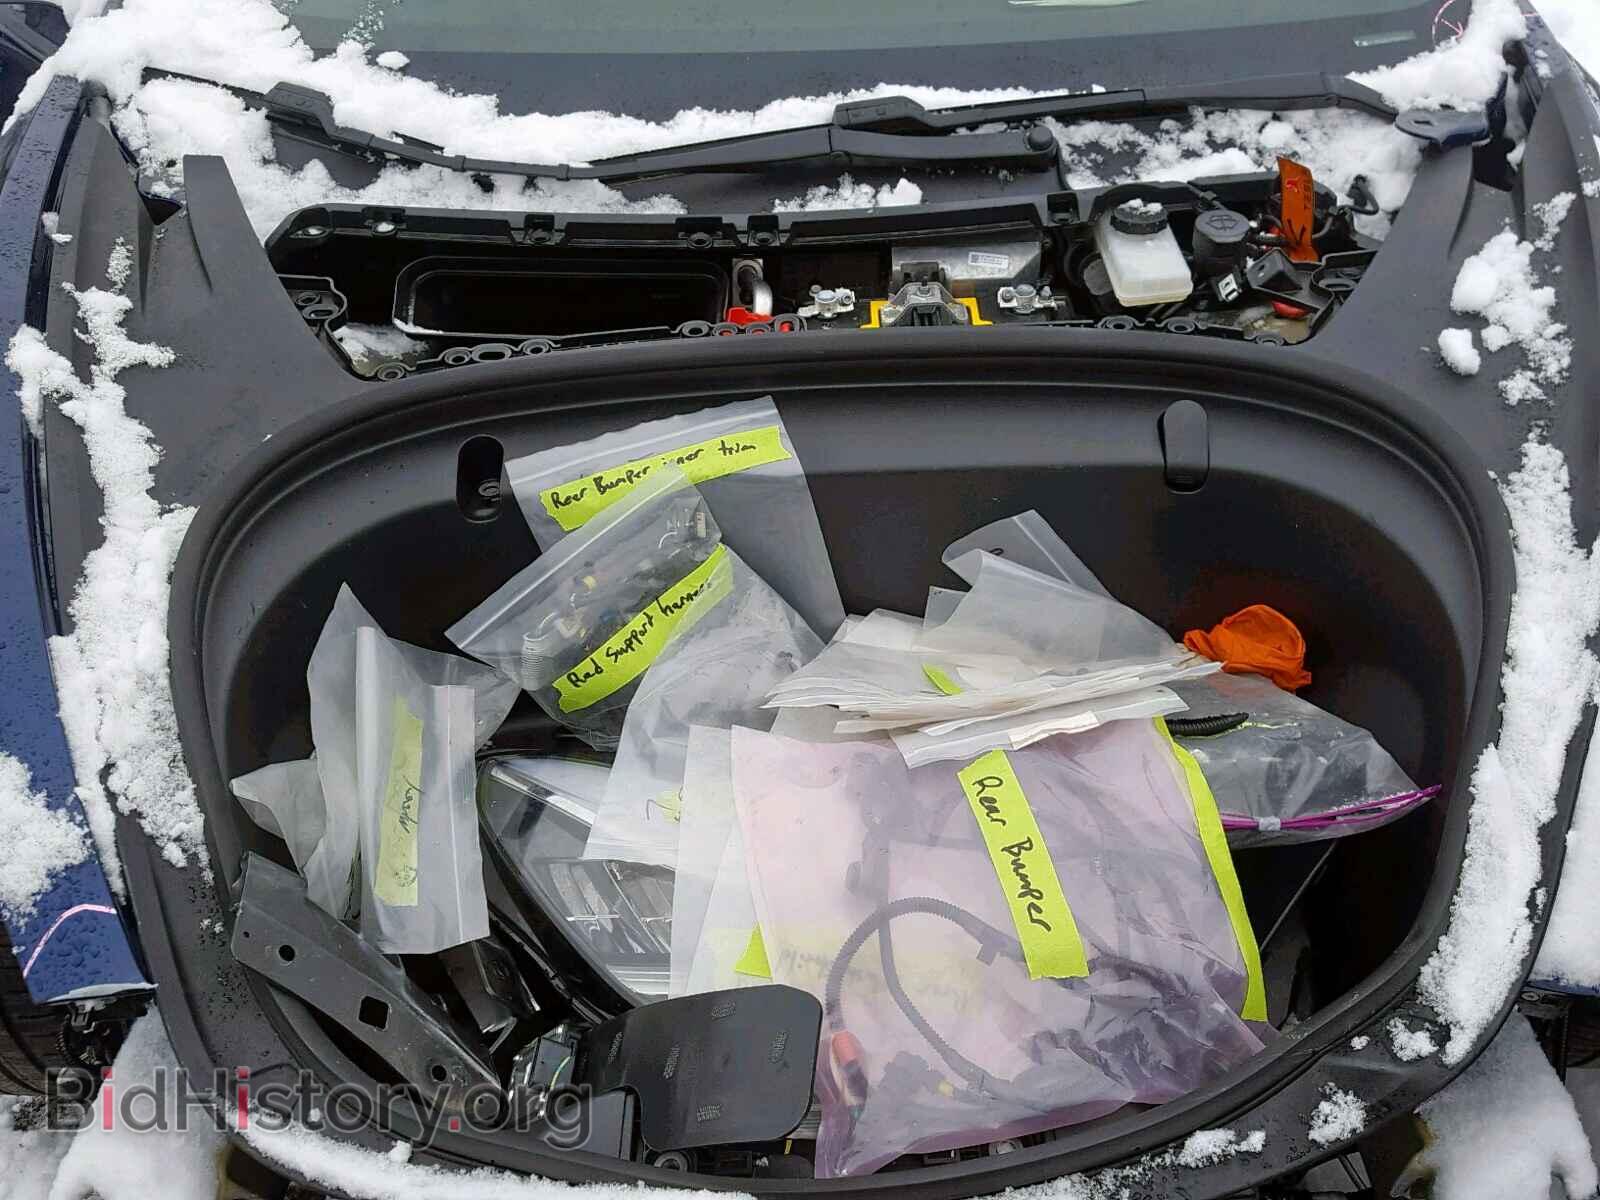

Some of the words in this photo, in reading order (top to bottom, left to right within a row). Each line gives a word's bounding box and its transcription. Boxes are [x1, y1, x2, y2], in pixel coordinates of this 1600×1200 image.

[593, 466, 651, 495] Bumper
[566, 657, 604, 688] Rad
[605, 611, 654, 664] Support
[972, 775, 1007, 827] Rear
[1001, 836, 1052, 932] Bumper
